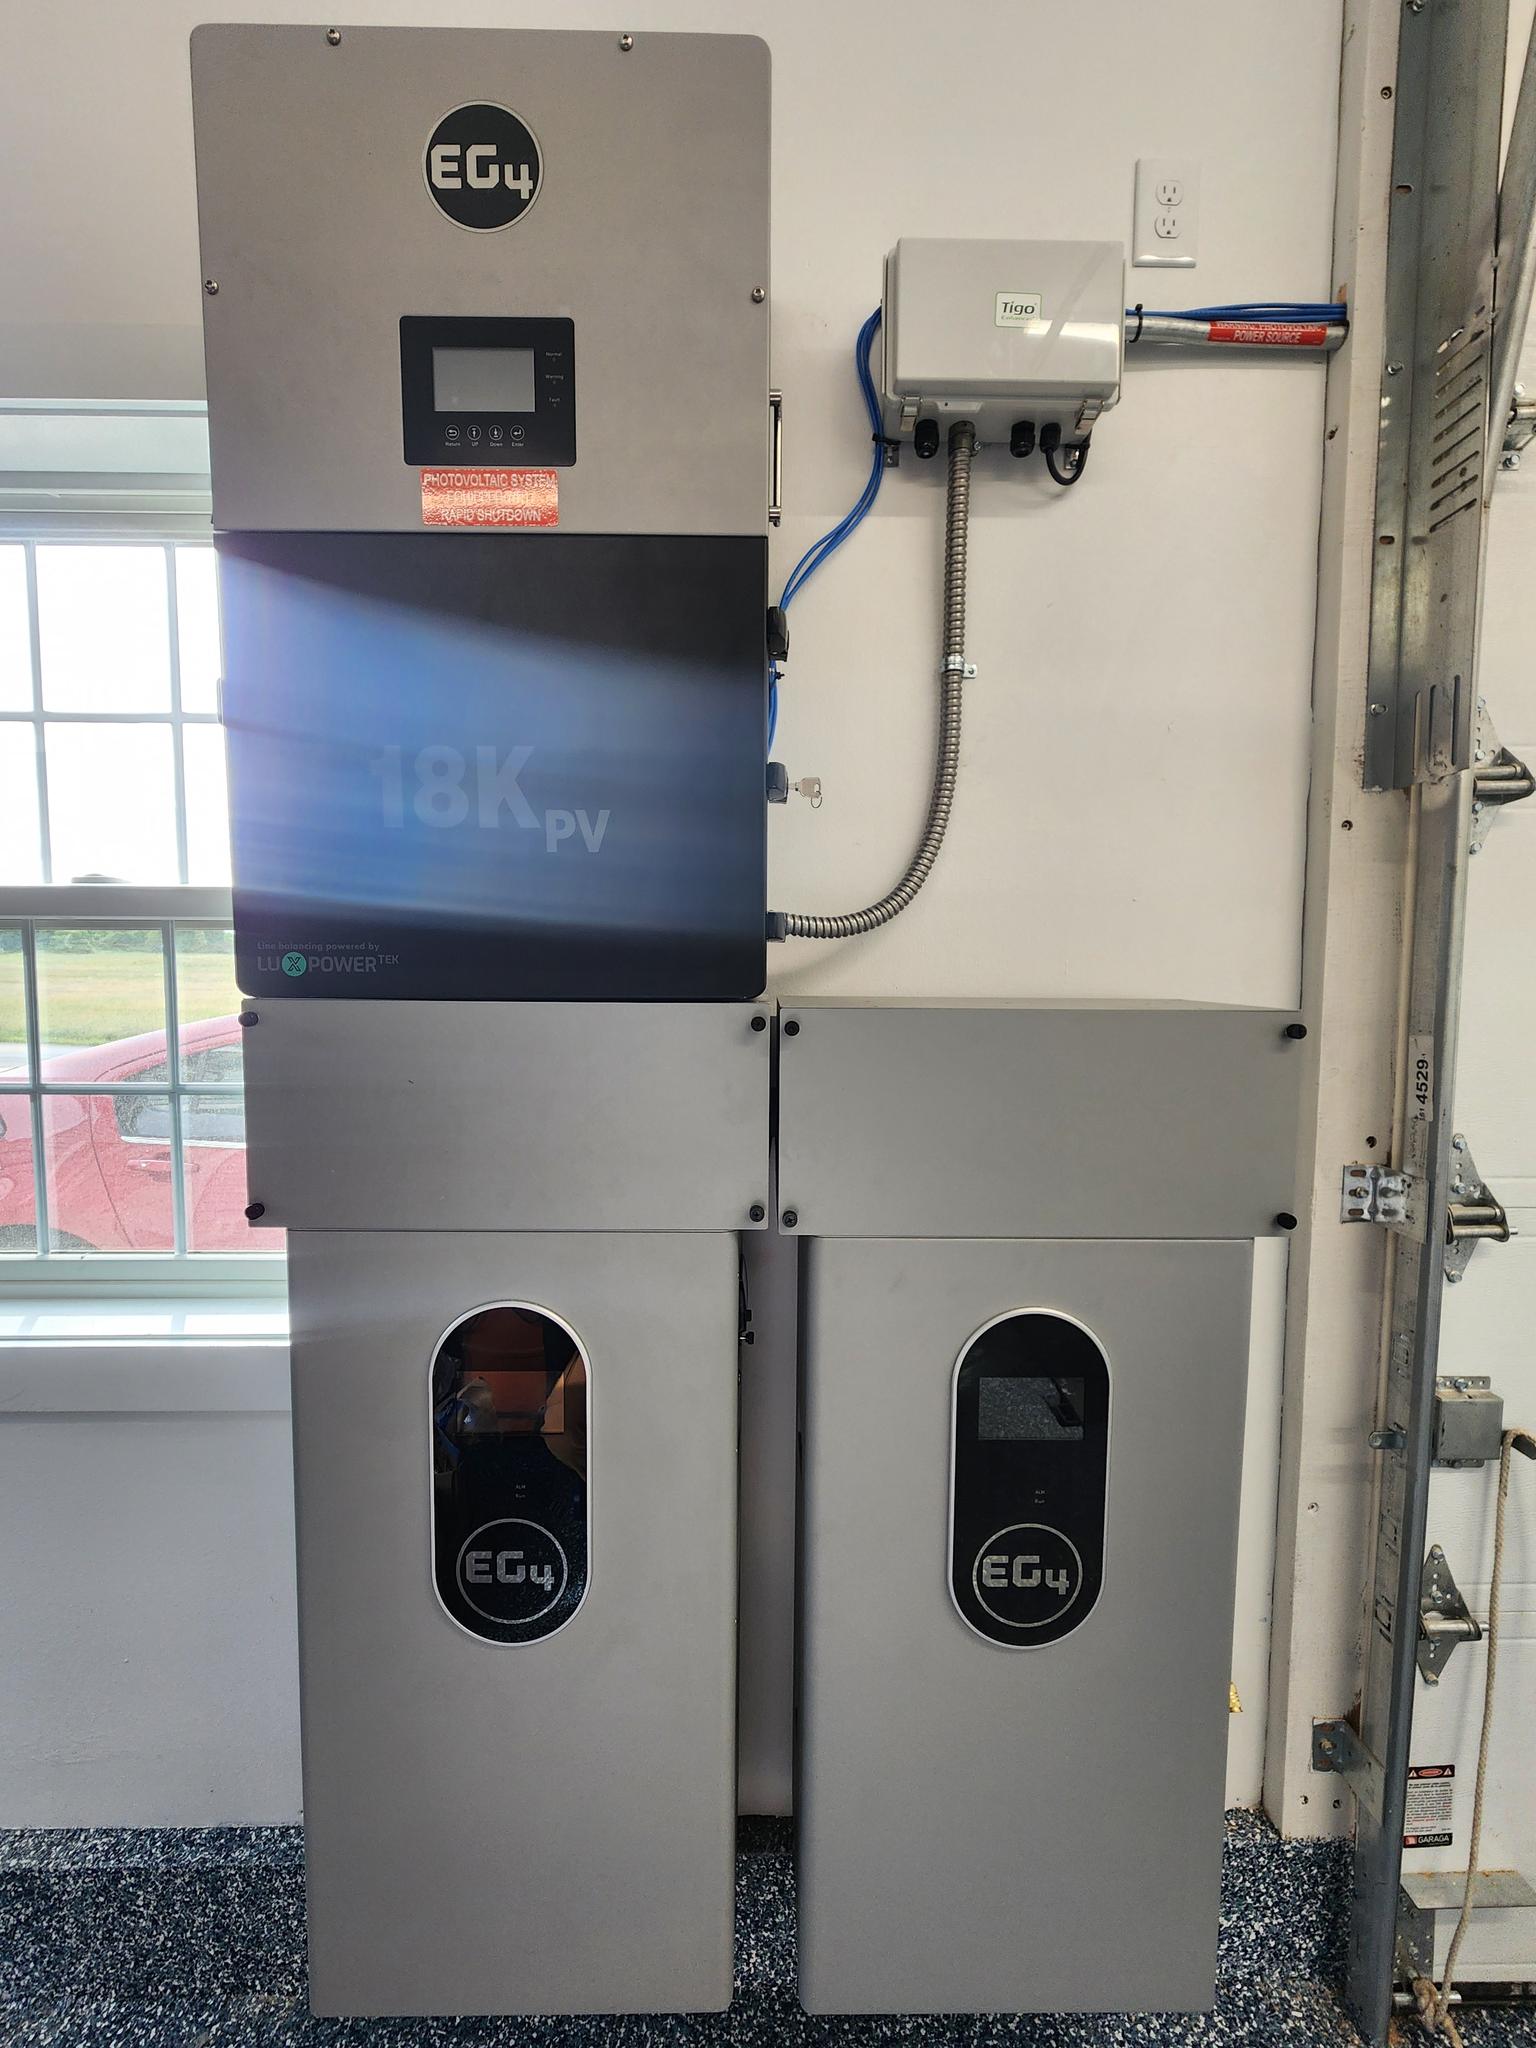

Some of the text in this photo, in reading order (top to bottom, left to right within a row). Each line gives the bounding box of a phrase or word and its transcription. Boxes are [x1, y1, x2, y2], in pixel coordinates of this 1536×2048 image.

[430, 144, 534, 200] EG4
[1002, 301, 1035, 316] Tigo
[1233, 330, 1302, 344] POWER SOURCE
[423, 473, 556, 488] PHOTOVOLTAIC SYSTEM
[441, 508, 541, 522] RAPID SHUTDOWN
[368, 745, 611, 852] 18K PV
[278, 941, 323, 952] balancing
[325, 942, 366, 952] powered
[368, 942, 380, 952] by
[1416, 1059, 1429, 1105] 4529
[465, 1551, 555, 1592] EG4
[982, 1555, 1070, 1596] EG4
[1418, 1834, 1449, 1844] GARAGA
